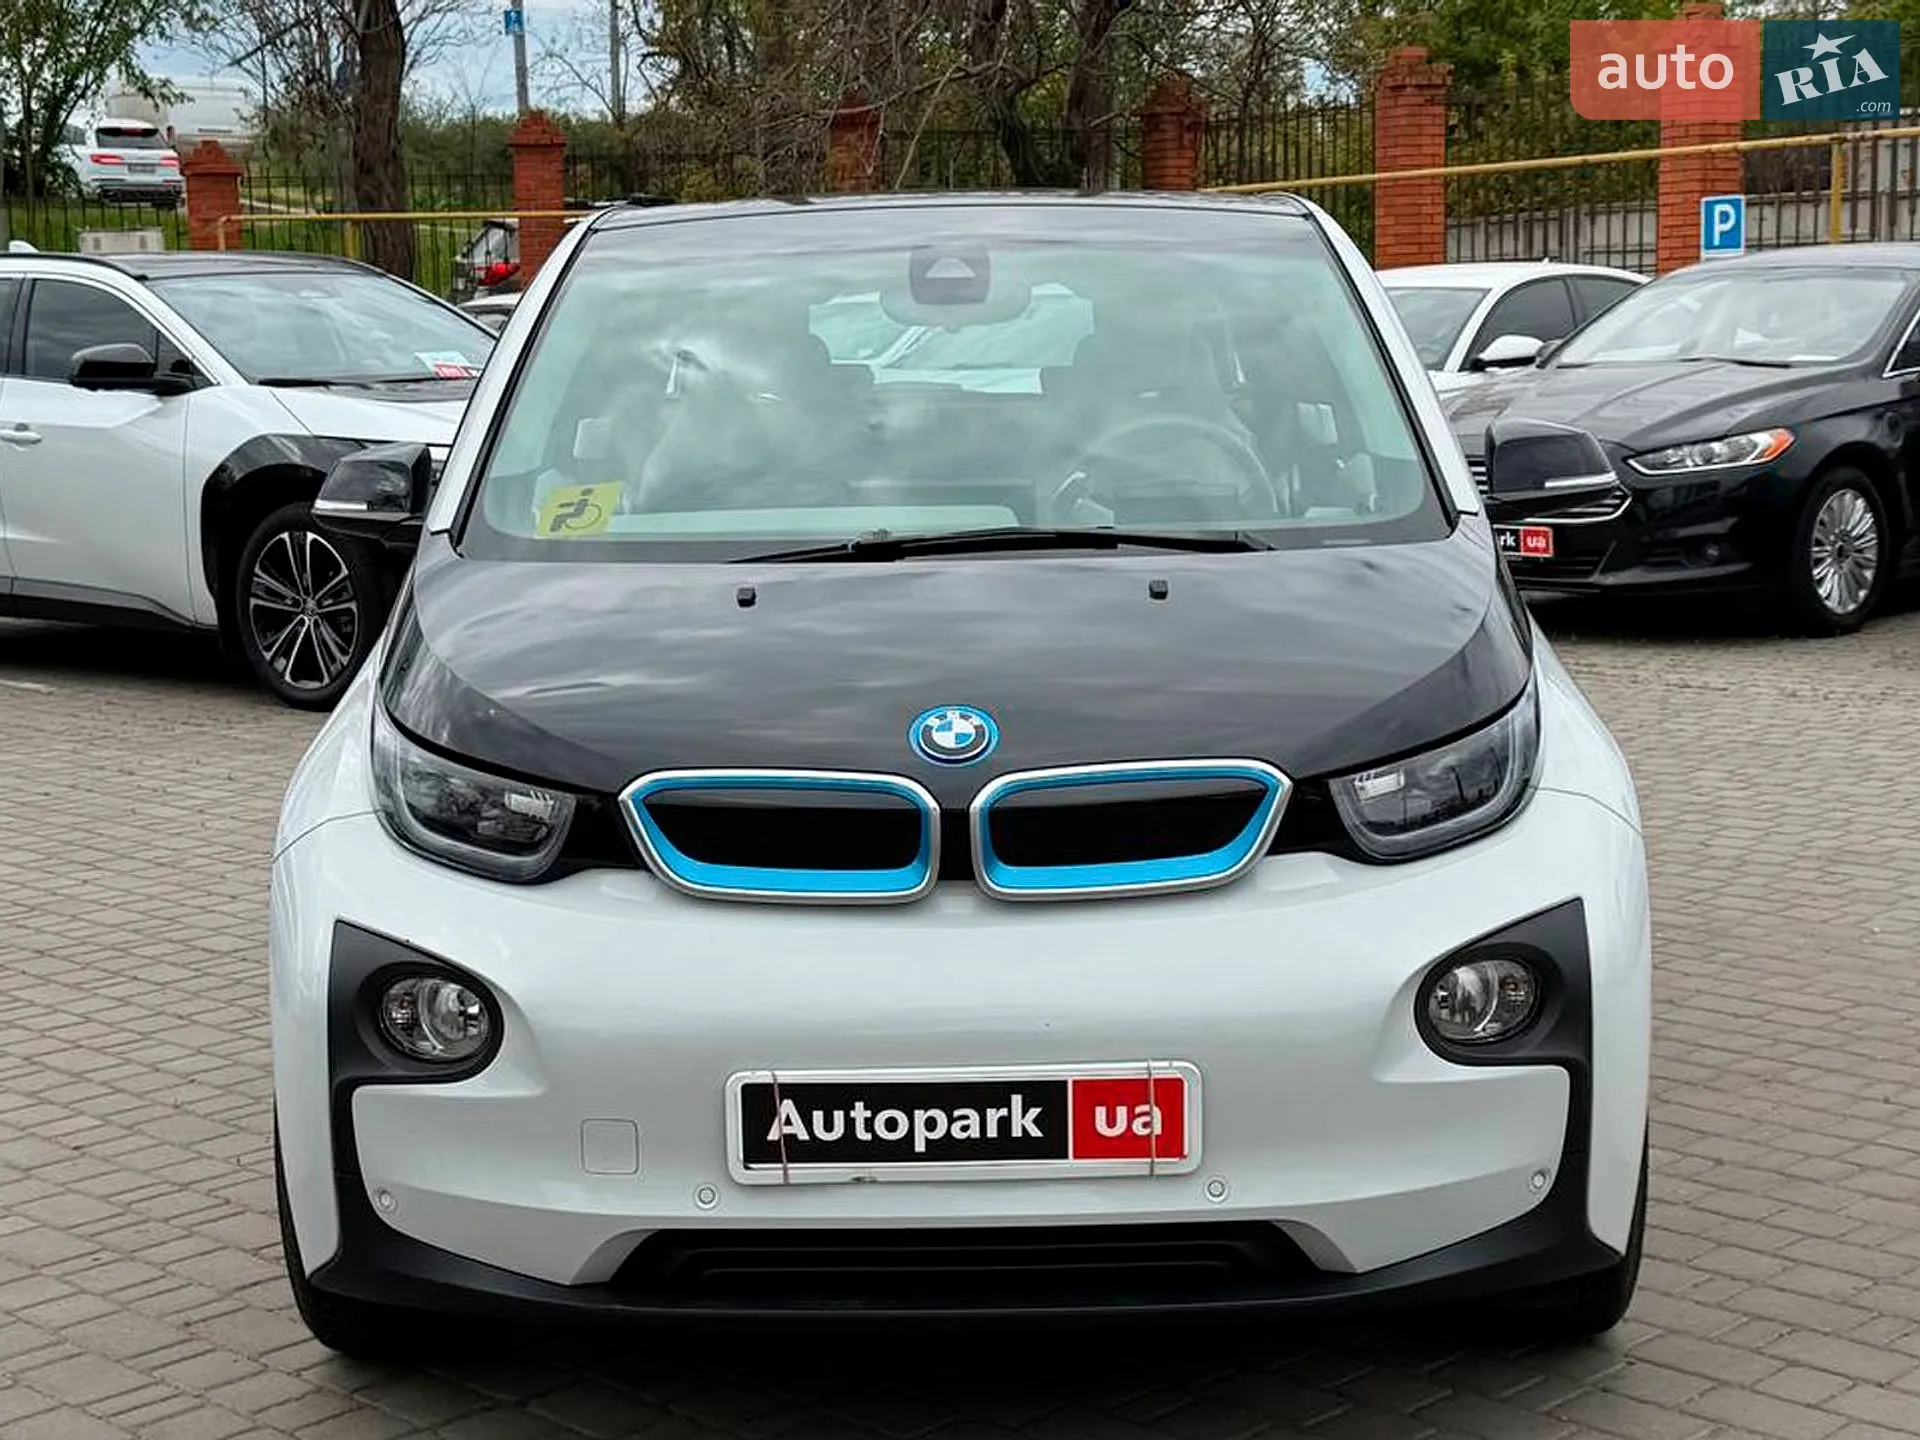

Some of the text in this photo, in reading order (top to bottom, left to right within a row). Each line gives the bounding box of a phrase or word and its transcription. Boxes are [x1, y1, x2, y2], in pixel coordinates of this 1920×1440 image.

[1713, 203, 1736, 245] P
[767, 1095, 1163, 1152] Autopark ua
